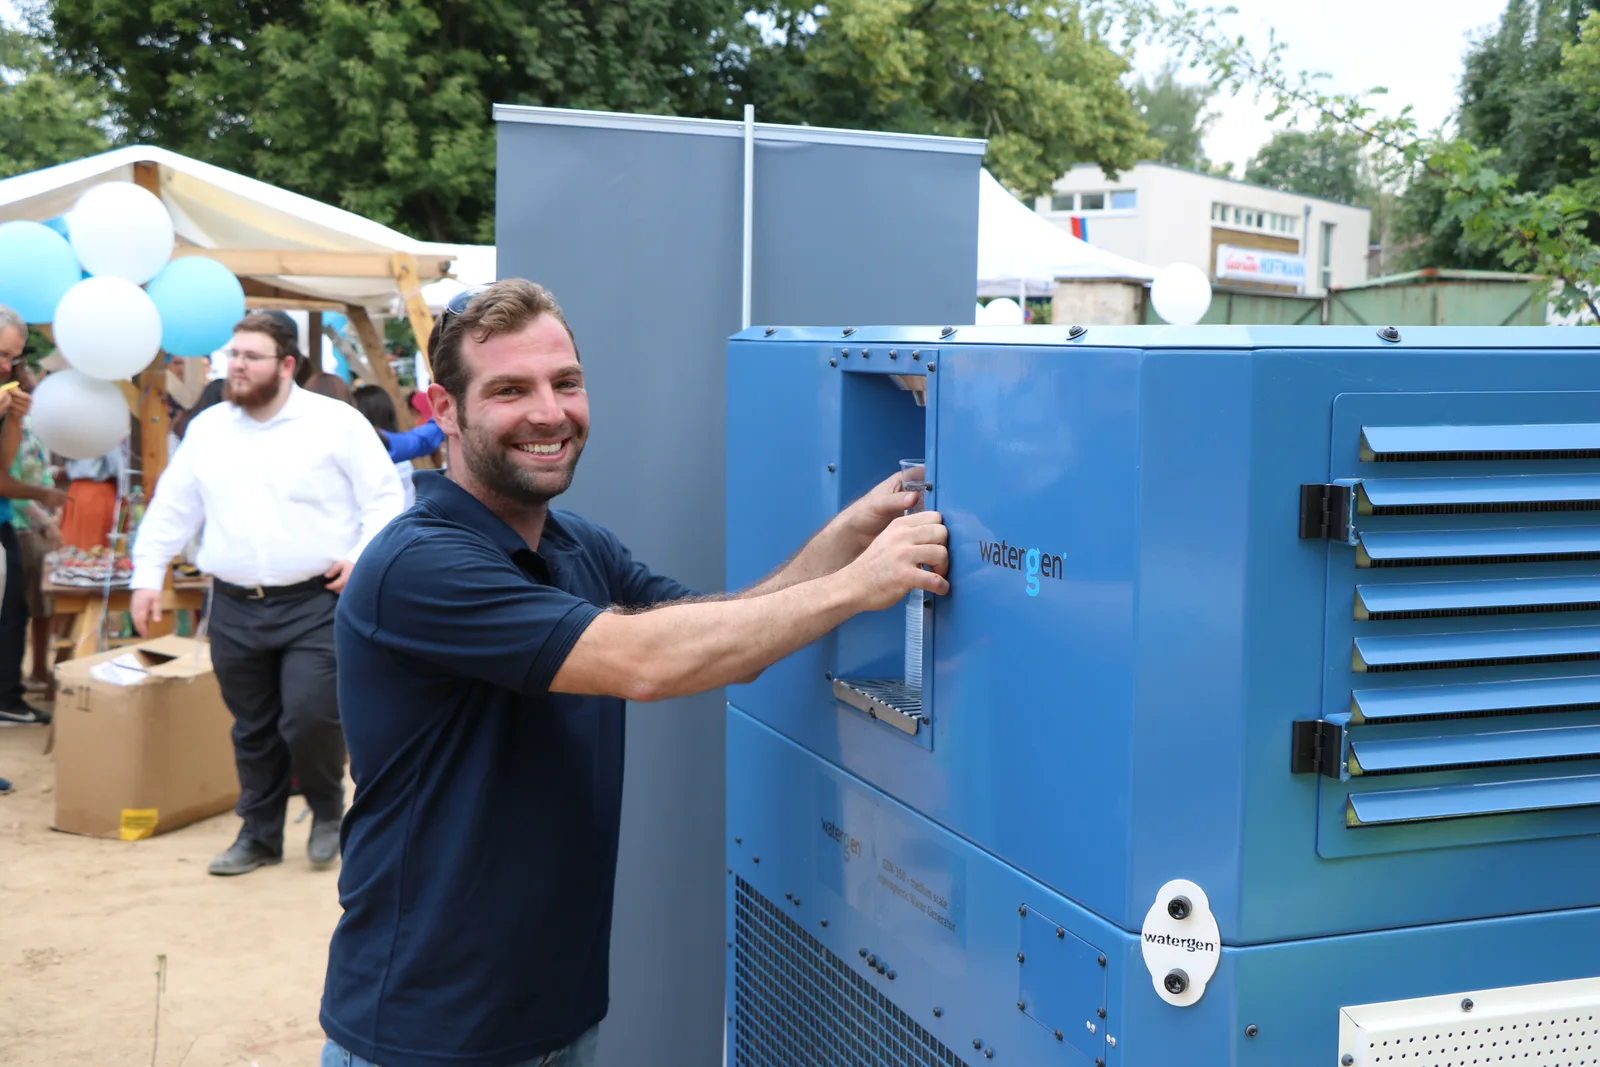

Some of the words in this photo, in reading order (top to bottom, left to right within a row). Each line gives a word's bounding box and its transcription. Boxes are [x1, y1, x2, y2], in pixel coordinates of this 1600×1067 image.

[979, 540, 1064, 597] watergen
[821, 817, 862, 863] watergen
[927, 904, 956, 934] Generator
[1144, 932, 1214, 953] watergen
